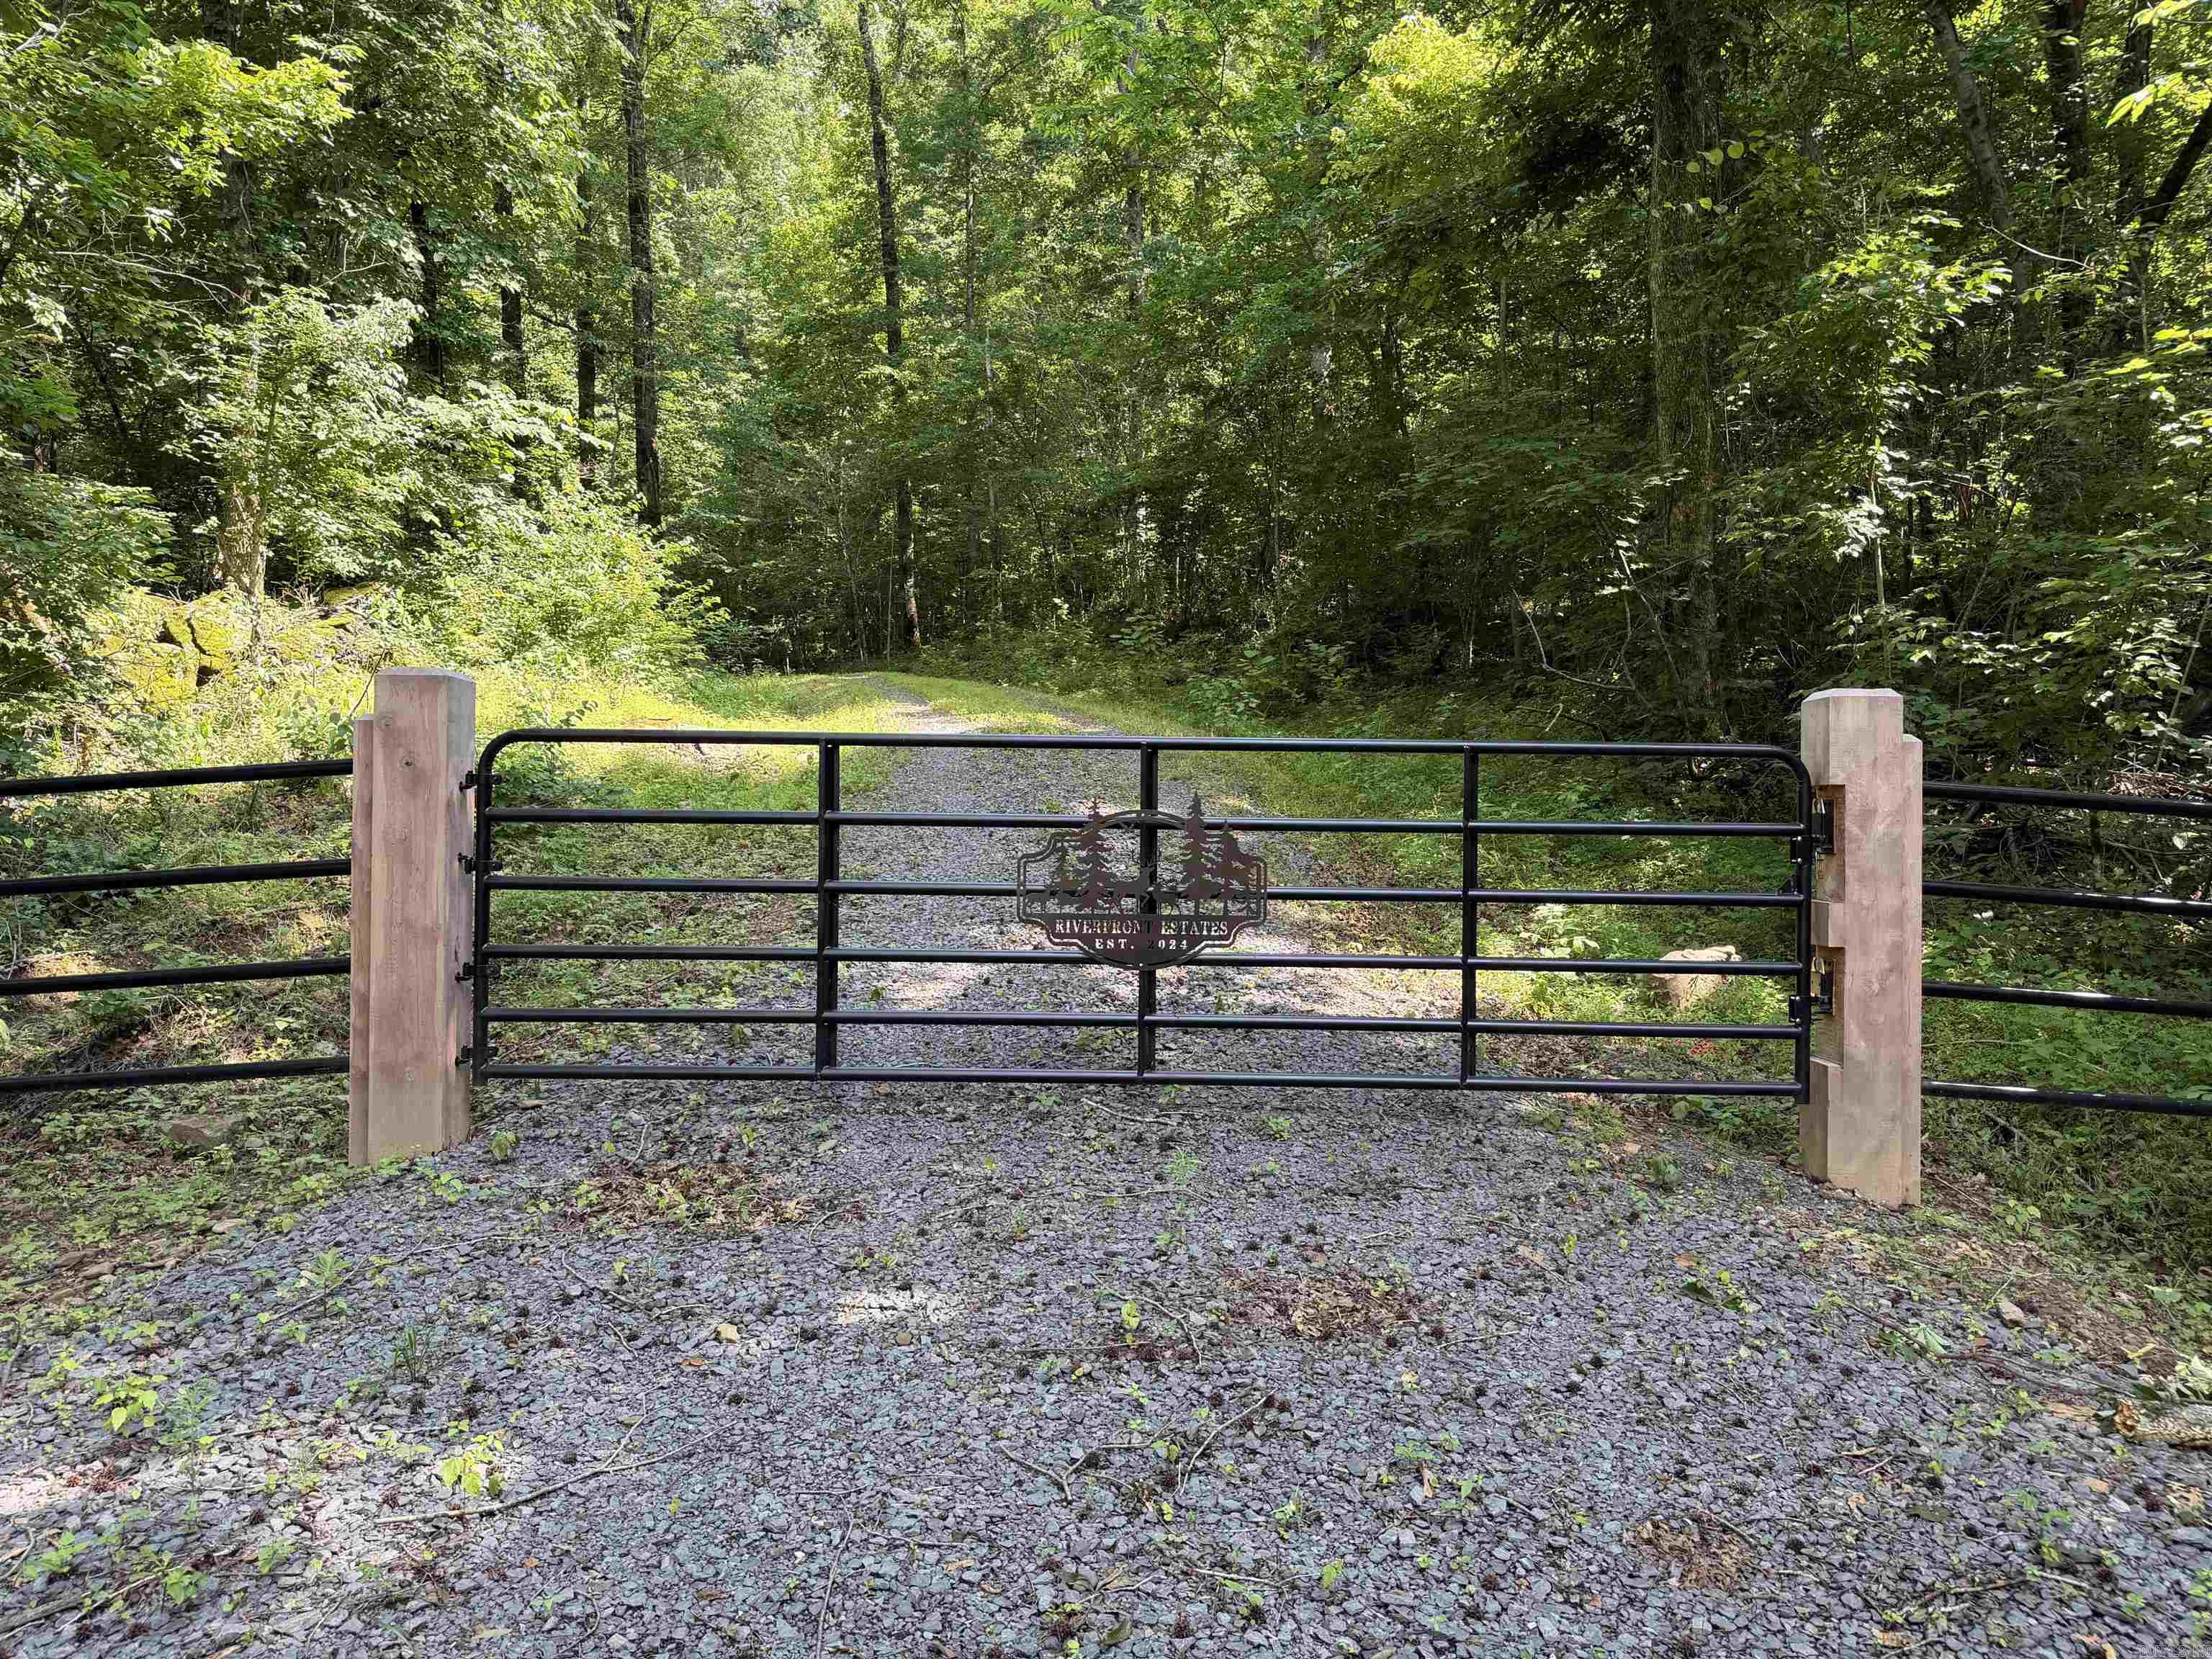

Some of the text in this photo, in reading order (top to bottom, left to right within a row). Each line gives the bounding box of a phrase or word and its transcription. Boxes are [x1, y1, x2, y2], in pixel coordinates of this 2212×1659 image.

[1160, 920, 1228, 935] ESTATES
[1094, 938, 1188, 950] EST. 2024
